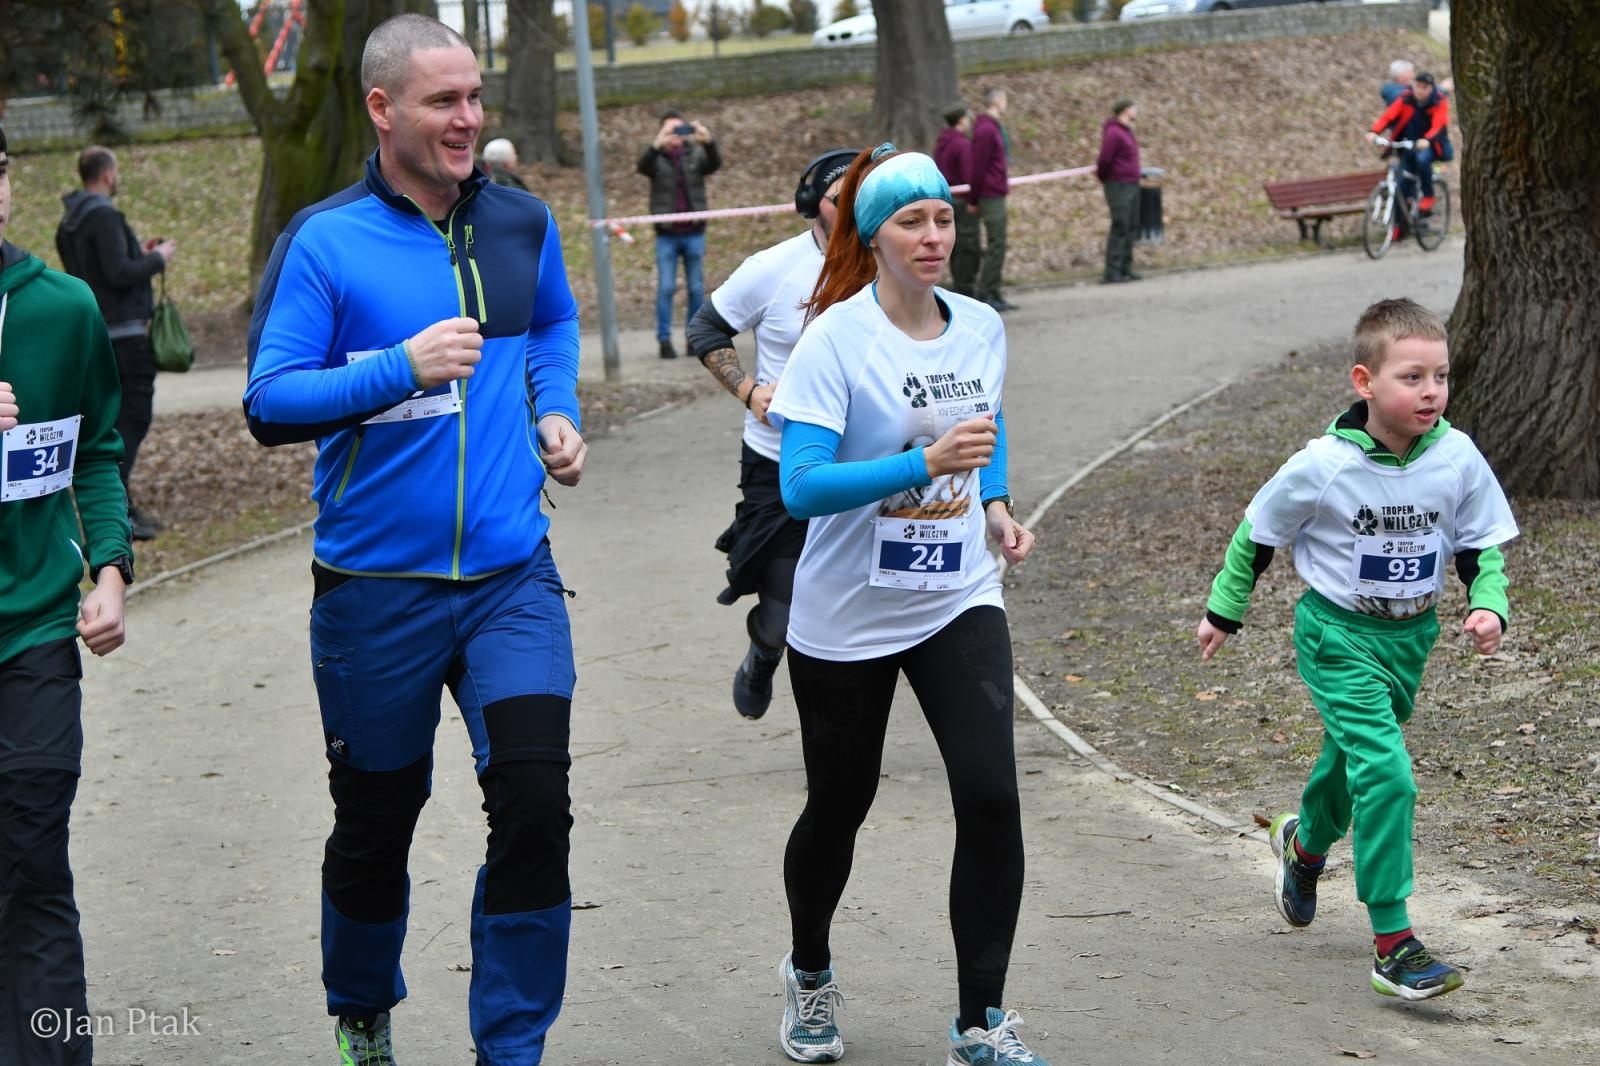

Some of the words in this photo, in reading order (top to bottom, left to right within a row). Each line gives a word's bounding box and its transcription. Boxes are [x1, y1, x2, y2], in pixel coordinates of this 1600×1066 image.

[925, 372, 955, 384] TROPEM
[929, 379, 984, 399] WILCZYM
[40, 430, 64, 442] WILCZYM
[32, 446, 59, 476] 34
[1382, 505, 1414, 515] TROPEM
[1383, 512, 1439, 531] WILCZYM
[920, 530, 948, 538] WILCZYM
[1398, 544, 1426, 553] WILCZYM
[909, 545, 944, 570] 24
[1388, 558, 1420, 581] 93
